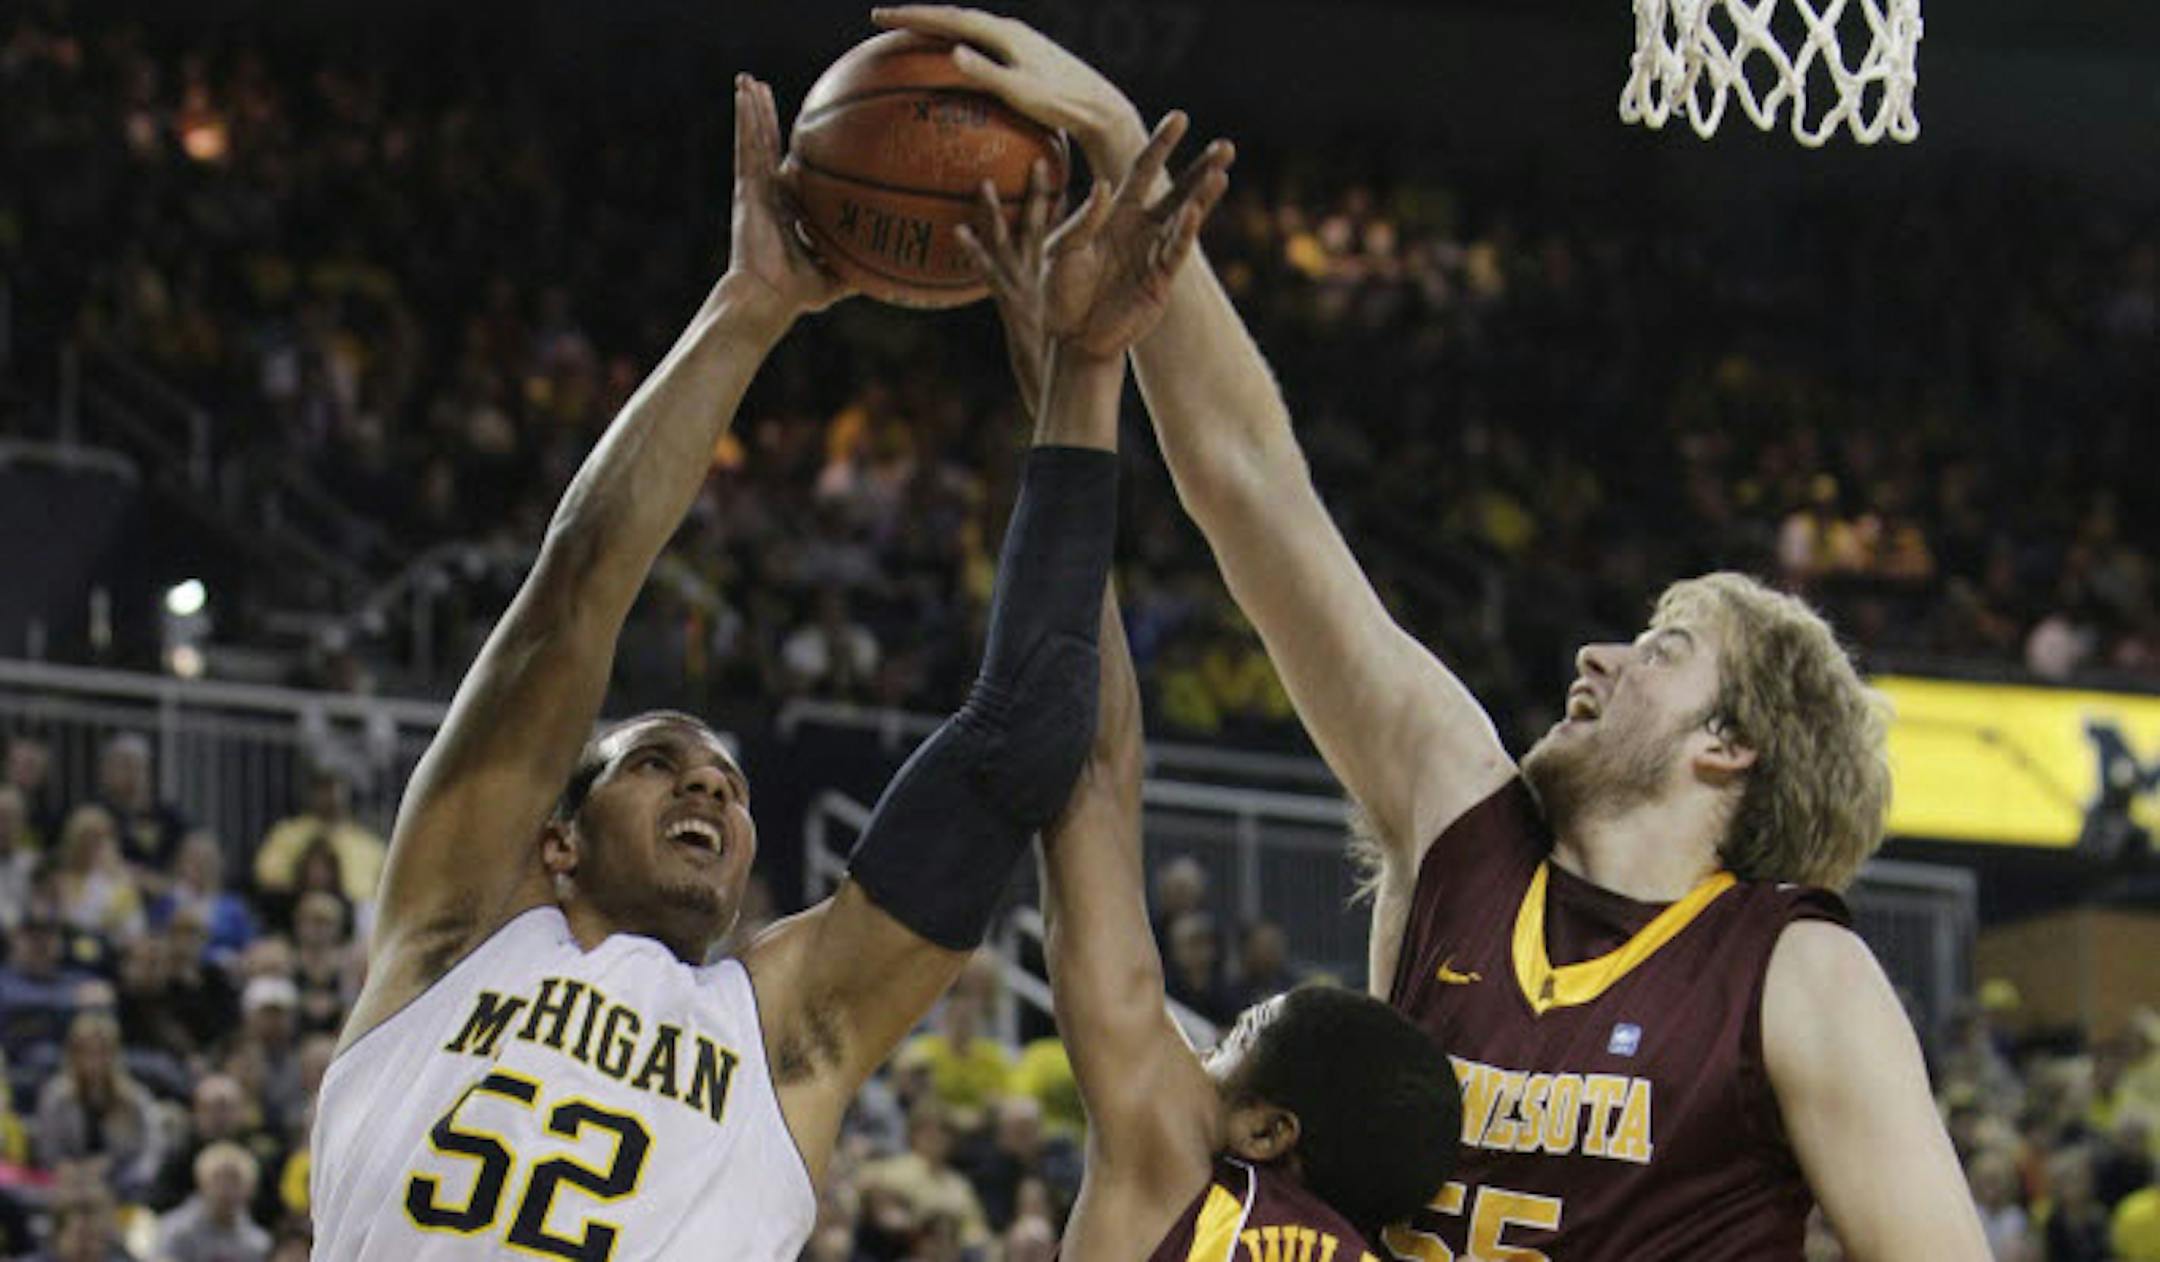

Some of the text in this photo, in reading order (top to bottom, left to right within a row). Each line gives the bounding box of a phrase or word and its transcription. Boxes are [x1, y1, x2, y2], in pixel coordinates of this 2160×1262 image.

[444, 976, 740, 1123] MHIGAN
[1447, 1054, 1653, 1166] NESOTA
[404, 1066, 656, 1262] 52
